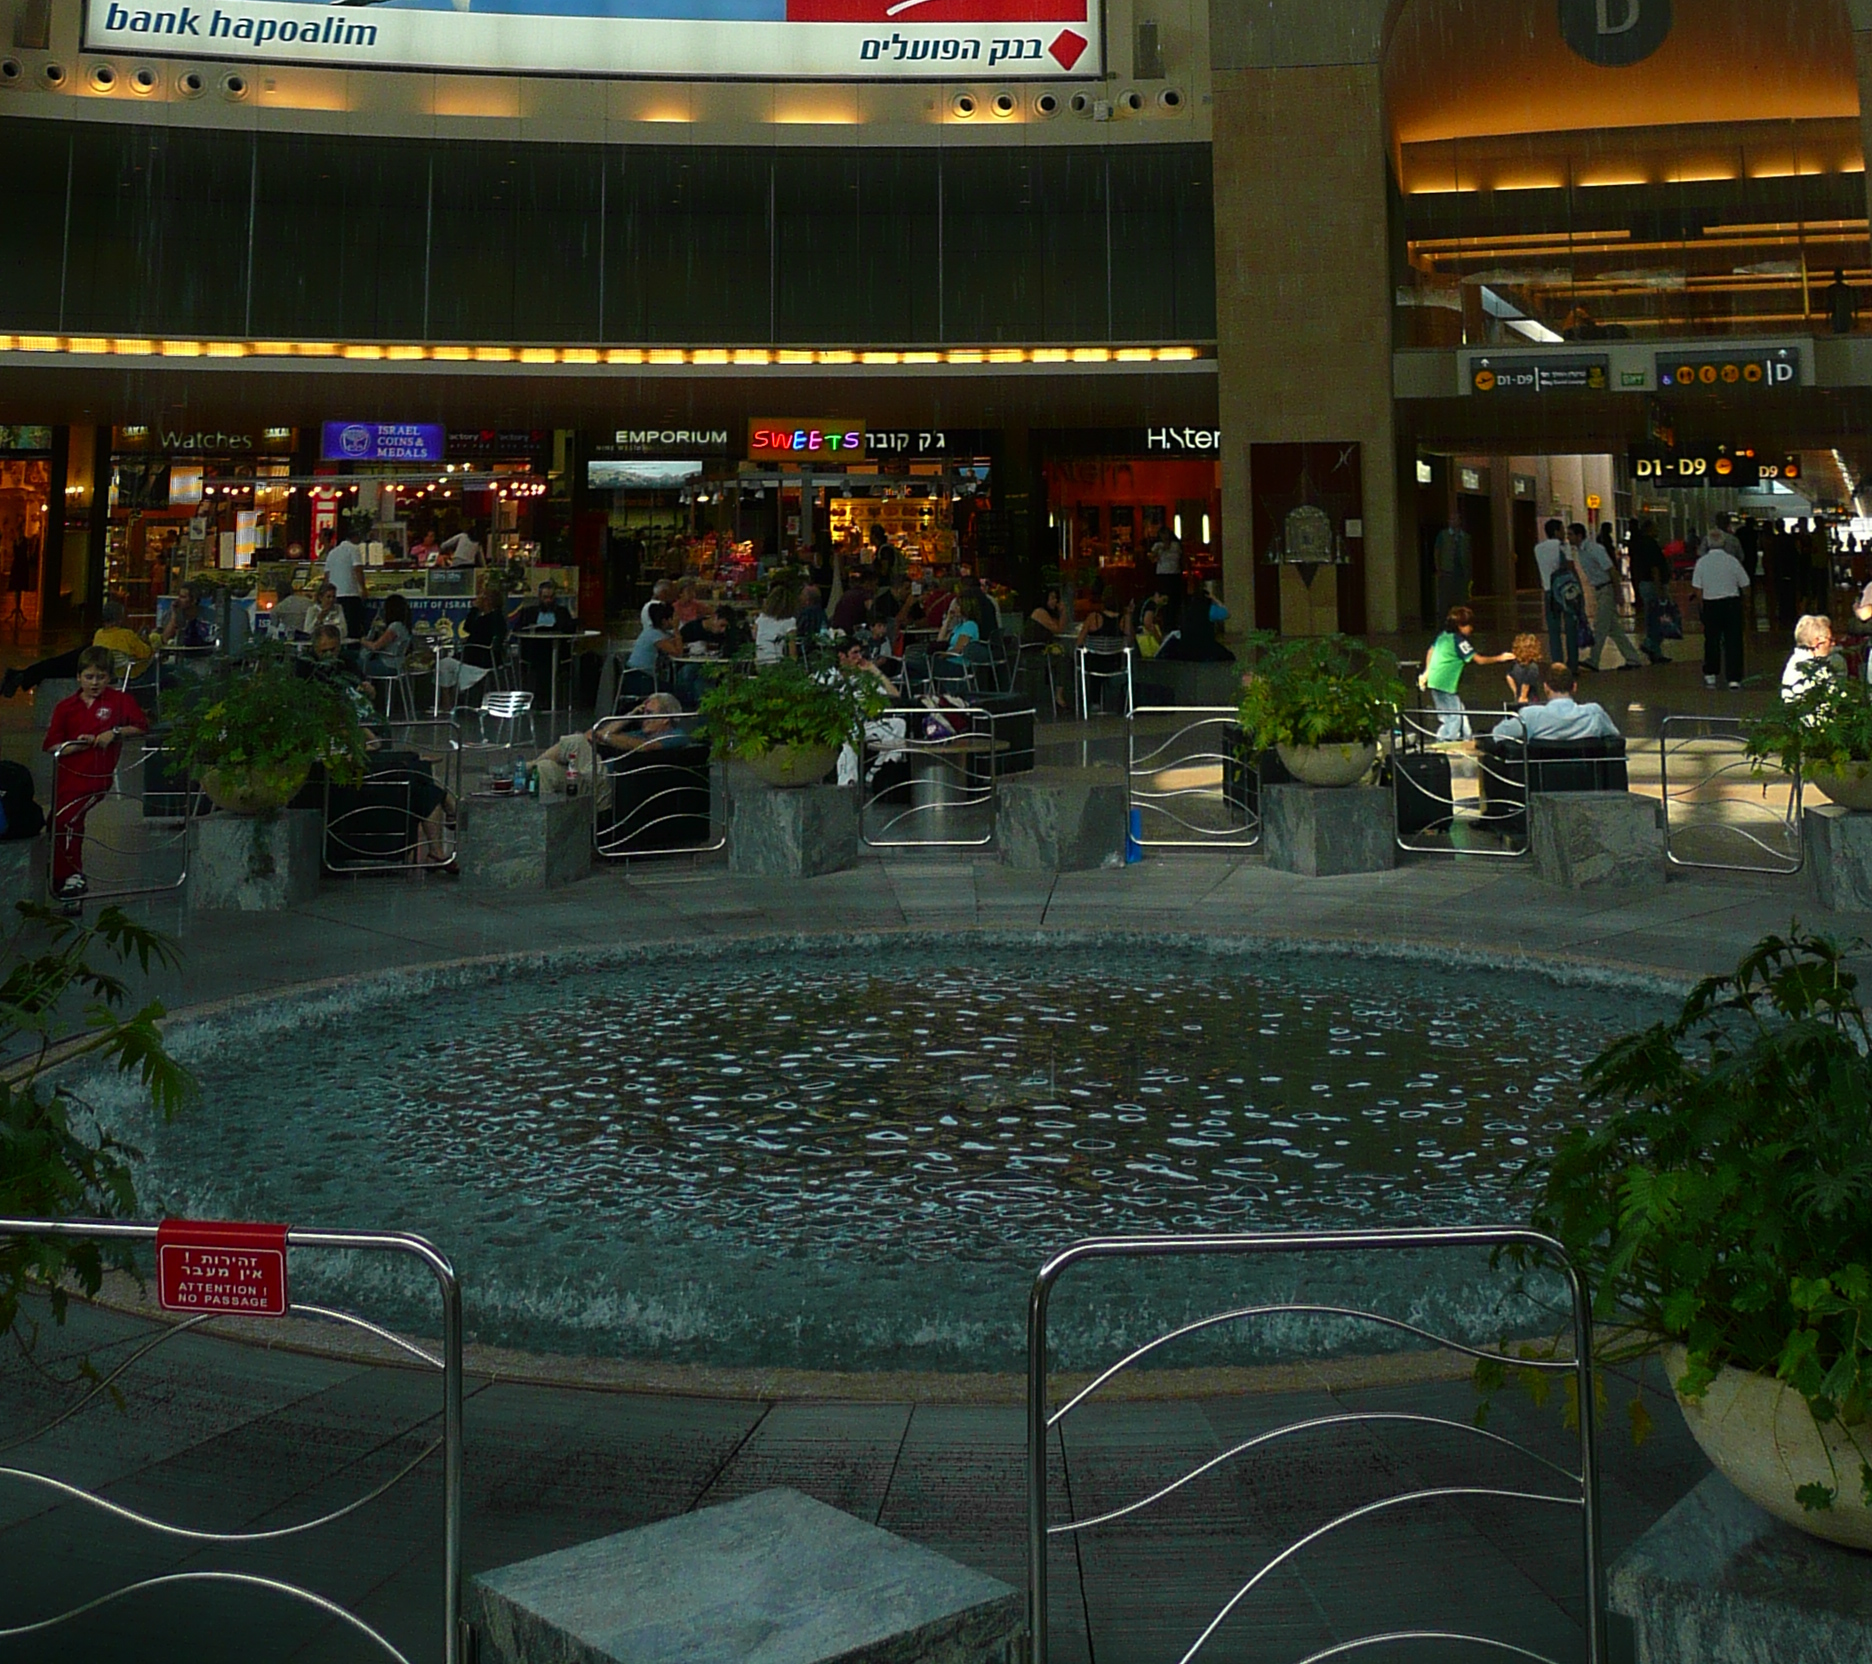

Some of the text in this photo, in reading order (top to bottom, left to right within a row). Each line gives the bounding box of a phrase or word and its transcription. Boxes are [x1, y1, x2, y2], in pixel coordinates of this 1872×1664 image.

[105, 2, 378, 46] bank hapoalim
[860, 33, 1043, 66] בנק הפועלים
[1775, 363, 1794, 382] D
[377, 425, 421, 436] ISRAEL
[615, 430, 728, 444] EMPORIUM
[160, 431, 253, 449] Watches
[752, 429, 860, 451] SWEETS
[377, 447, 428, 458] MEDALS
[201, 1254, 258, 1267] זהירות
[181, 1265, 263, 1281] אין מעבר
[178, 1281, 257, 1296] ATTENTION
[178, 1293, 268, 1308] NO PASSAGE
